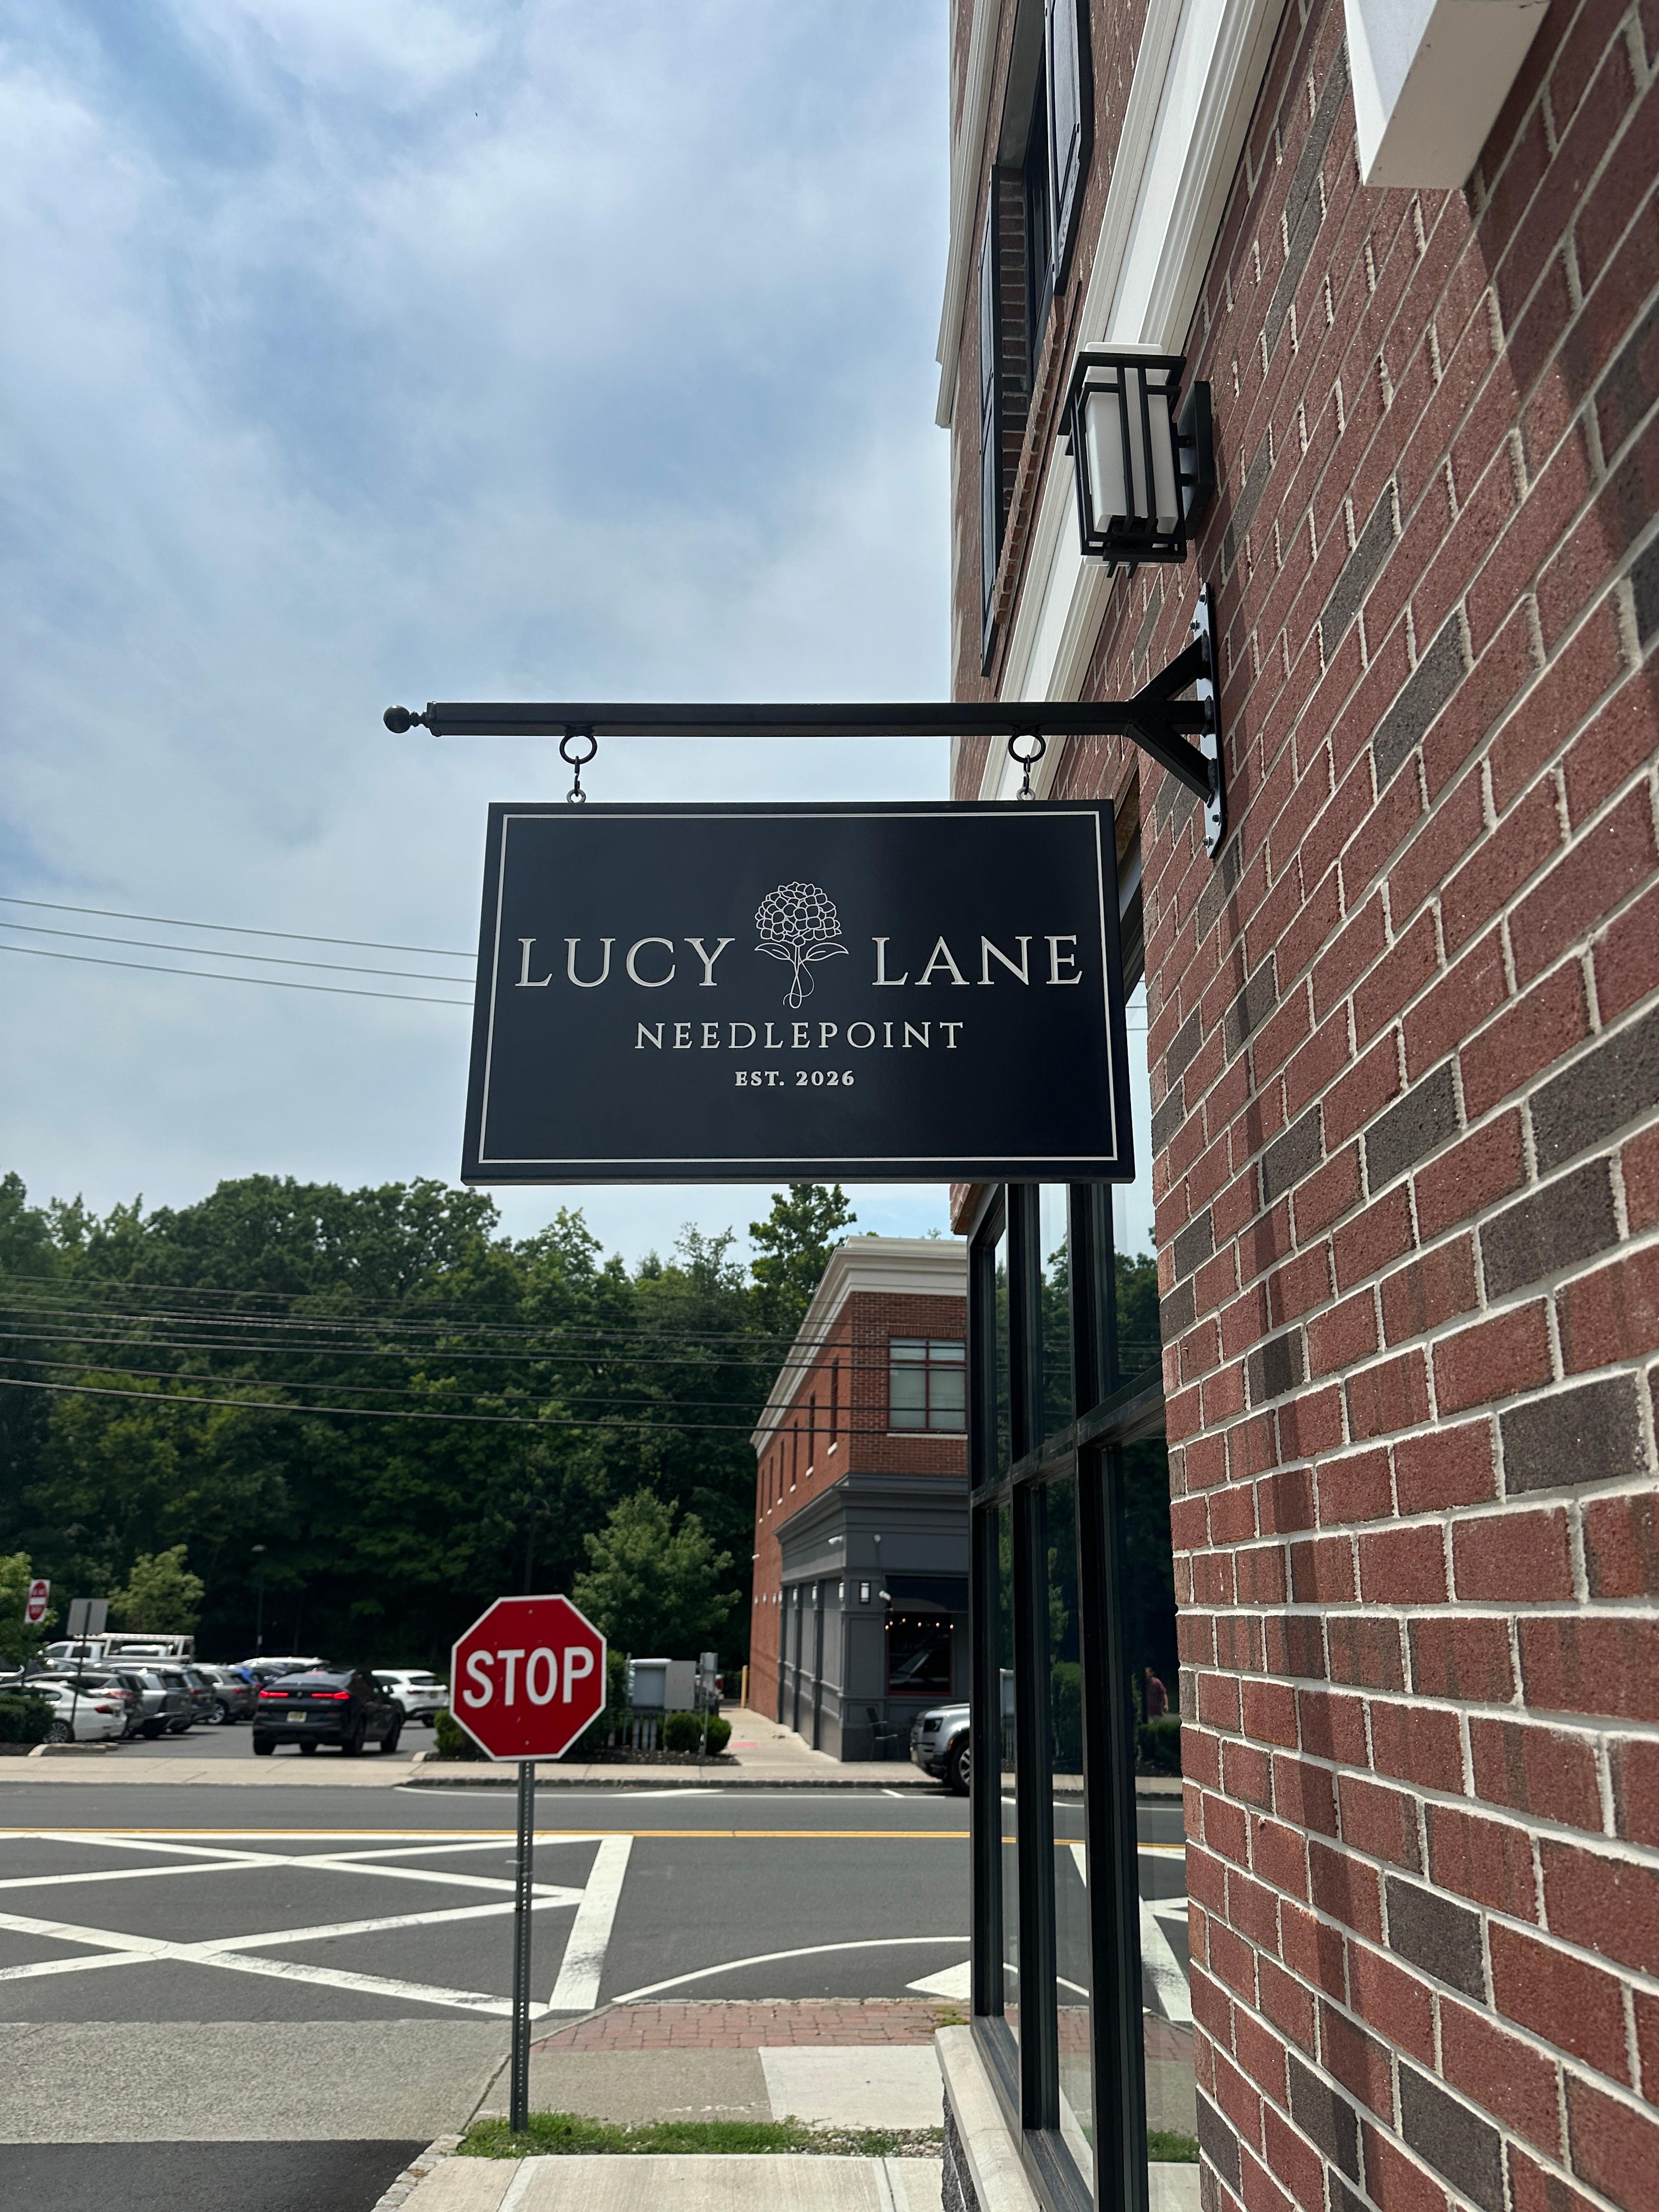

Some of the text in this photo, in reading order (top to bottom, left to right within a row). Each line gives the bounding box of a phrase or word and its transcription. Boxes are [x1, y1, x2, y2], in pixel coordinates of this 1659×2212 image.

[515, 934, 1083, 987] LUCY LANE
[634, 1021, 964, 1049] NEEDLEPOINT
[735, 1070, 855, 1087] EST. 2026
[463, 1646, 594, 1708] STOP
